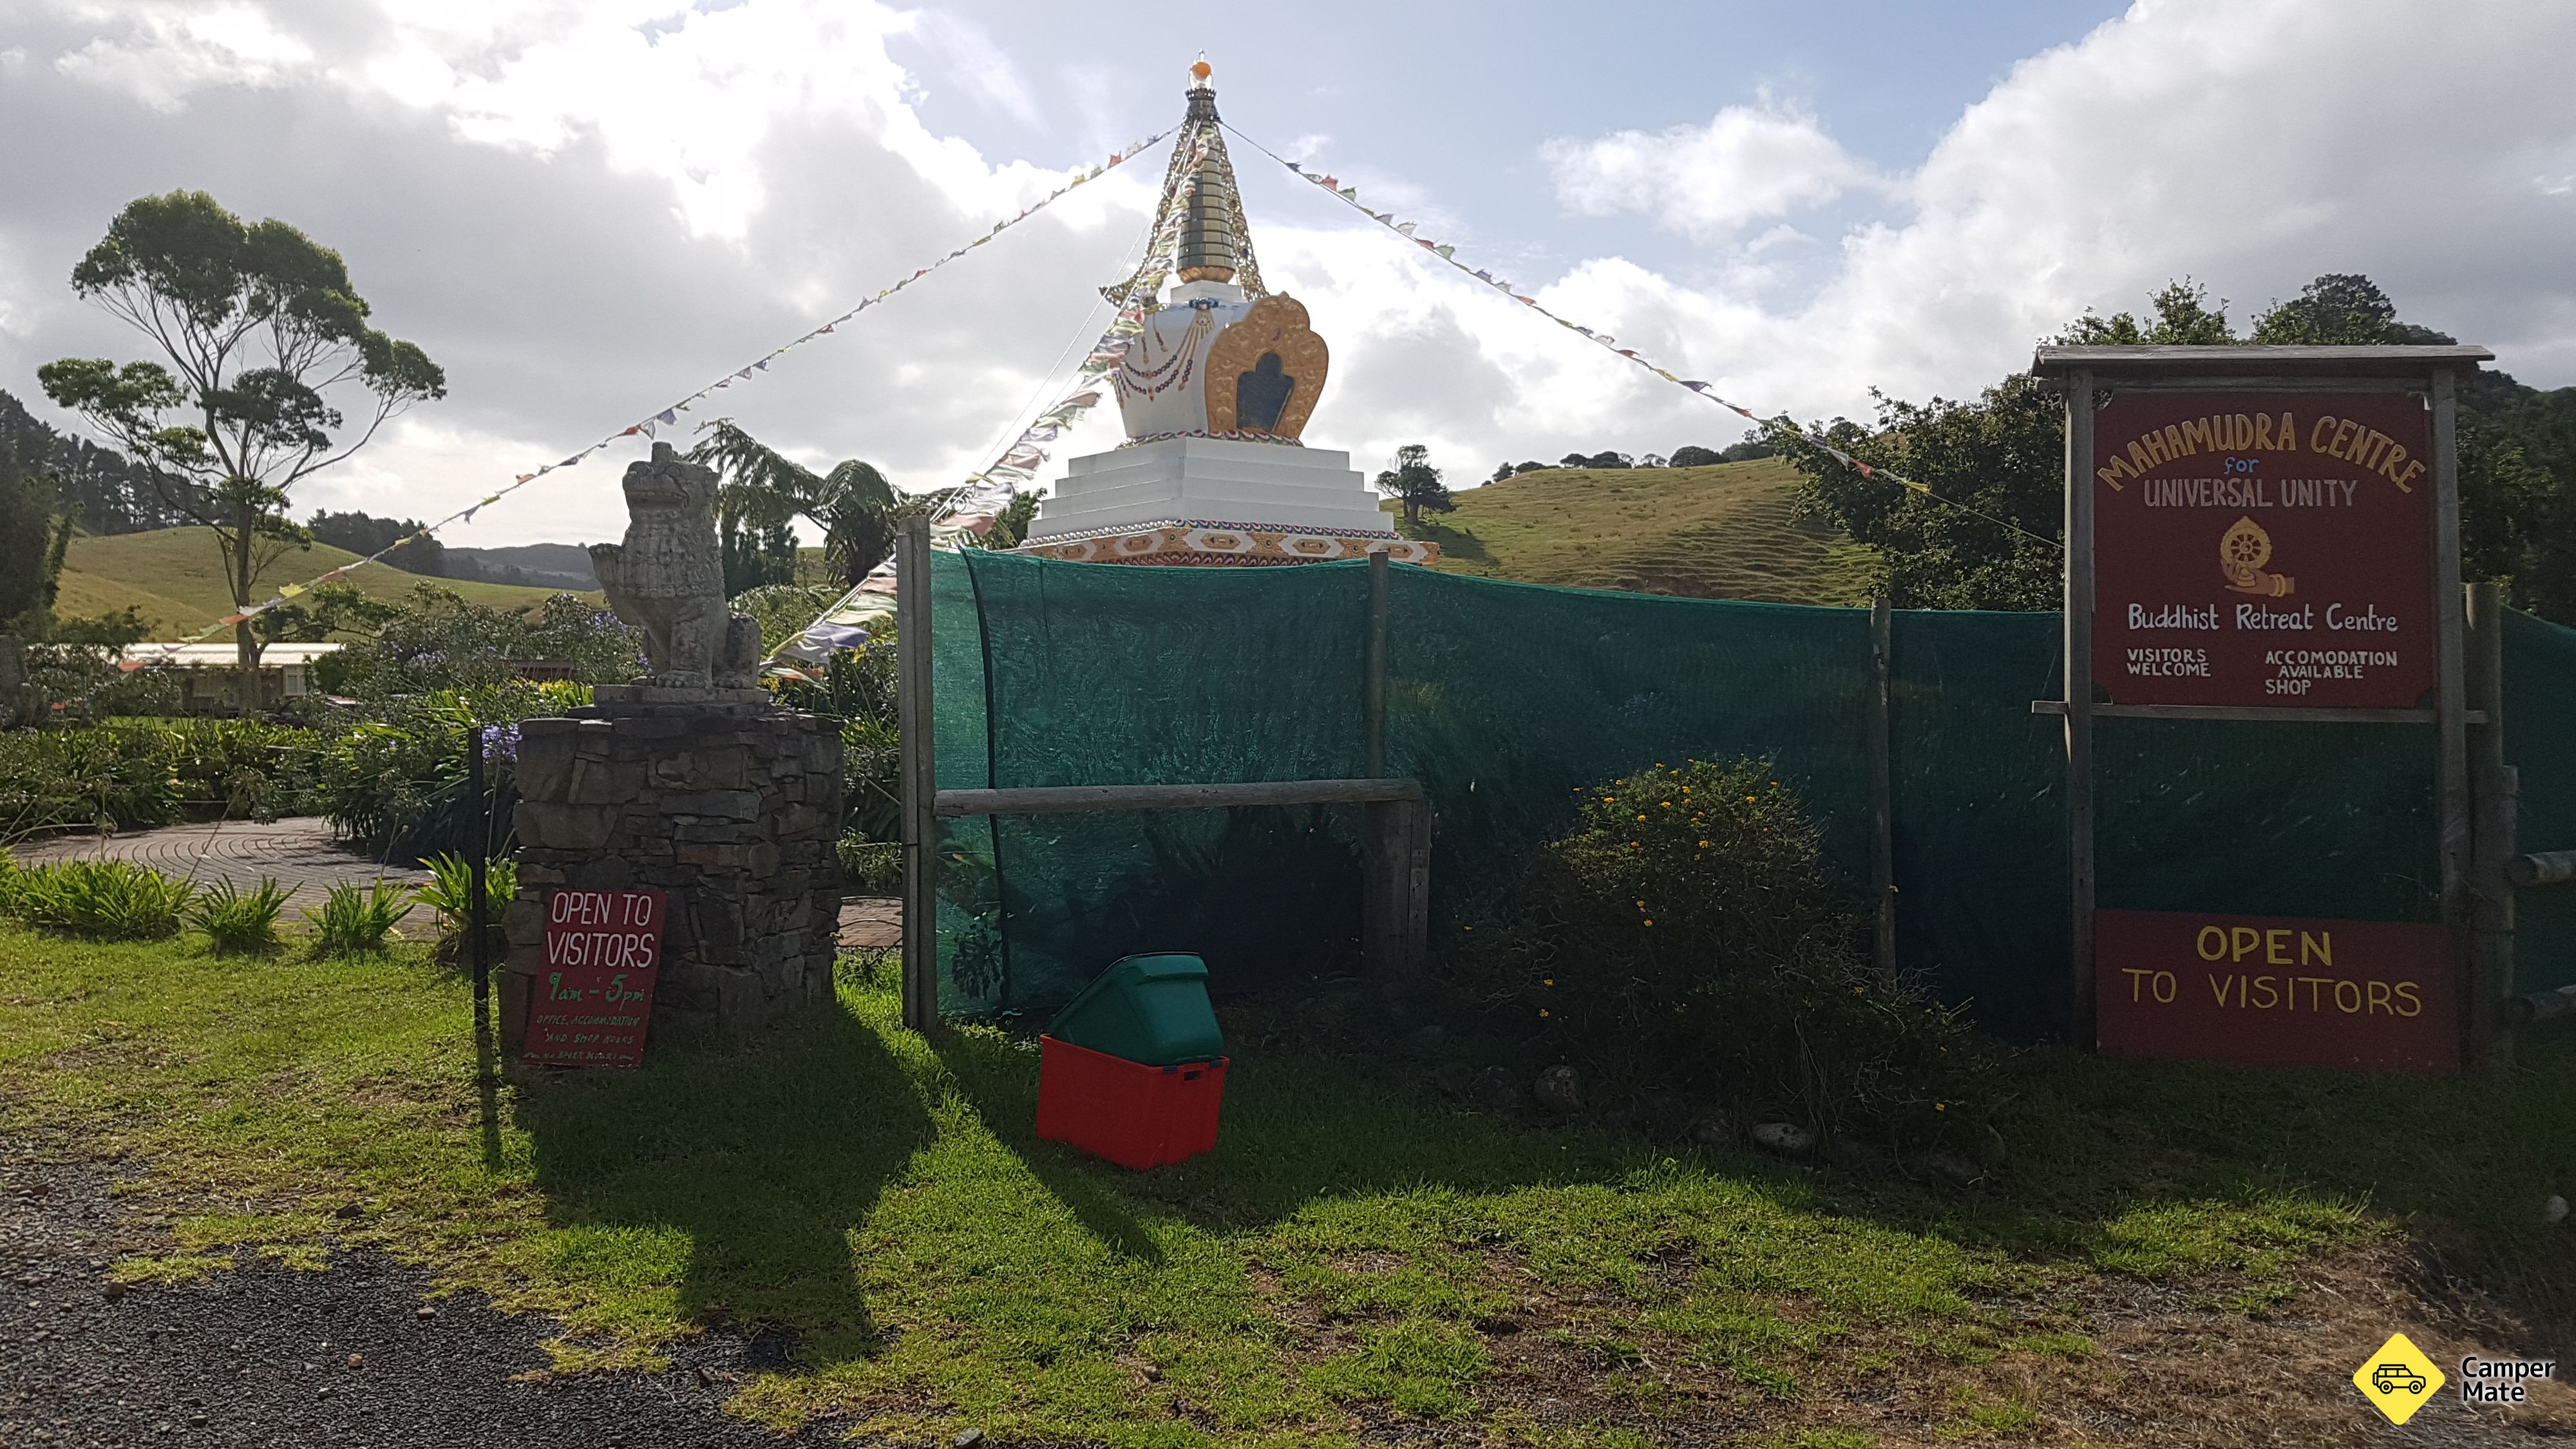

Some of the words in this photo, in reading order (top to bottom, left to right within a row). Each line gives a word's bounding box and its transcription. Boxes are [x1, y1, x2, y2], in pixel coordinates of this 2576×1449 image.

[2097, 412, 2297, 491] MAHAMUDRA
[2311, 415, 2426, 493] CENTRE
[2224, 456, 2259, 475] for
[2144, 478, 2273, 507] UNIVERSAL
[2280, 478, 2358, 507] UNITY
[2128, 603, 2220, 630] Buddhist
[2236, 603, 2314, 630] Retreat
[2326, 603, 2399, 632] Centre
[2126, 648, 2207, 663] VISITORS
[2126, 662, 2211, 677] WELCOME
[2265, 650, 2398, 667] ACCOMODATION
[2278, 665, 2364, 679] AVAILABLE
[2265, 679, 2312, 696] SHOP
[551, 892, 612, 925] OPEN
[623, 893, 652, 927] TO
[547, 931, 655, 968] VISITORS
[2197, 925, 2333, 967] OPEN
[548, 971, 583, 1002] 9am
[605, 974, 645, 1012] 5pm
[2121, 967, 2177, 1003] TO
[2208, 973, 2422, 1018] VISITORS
